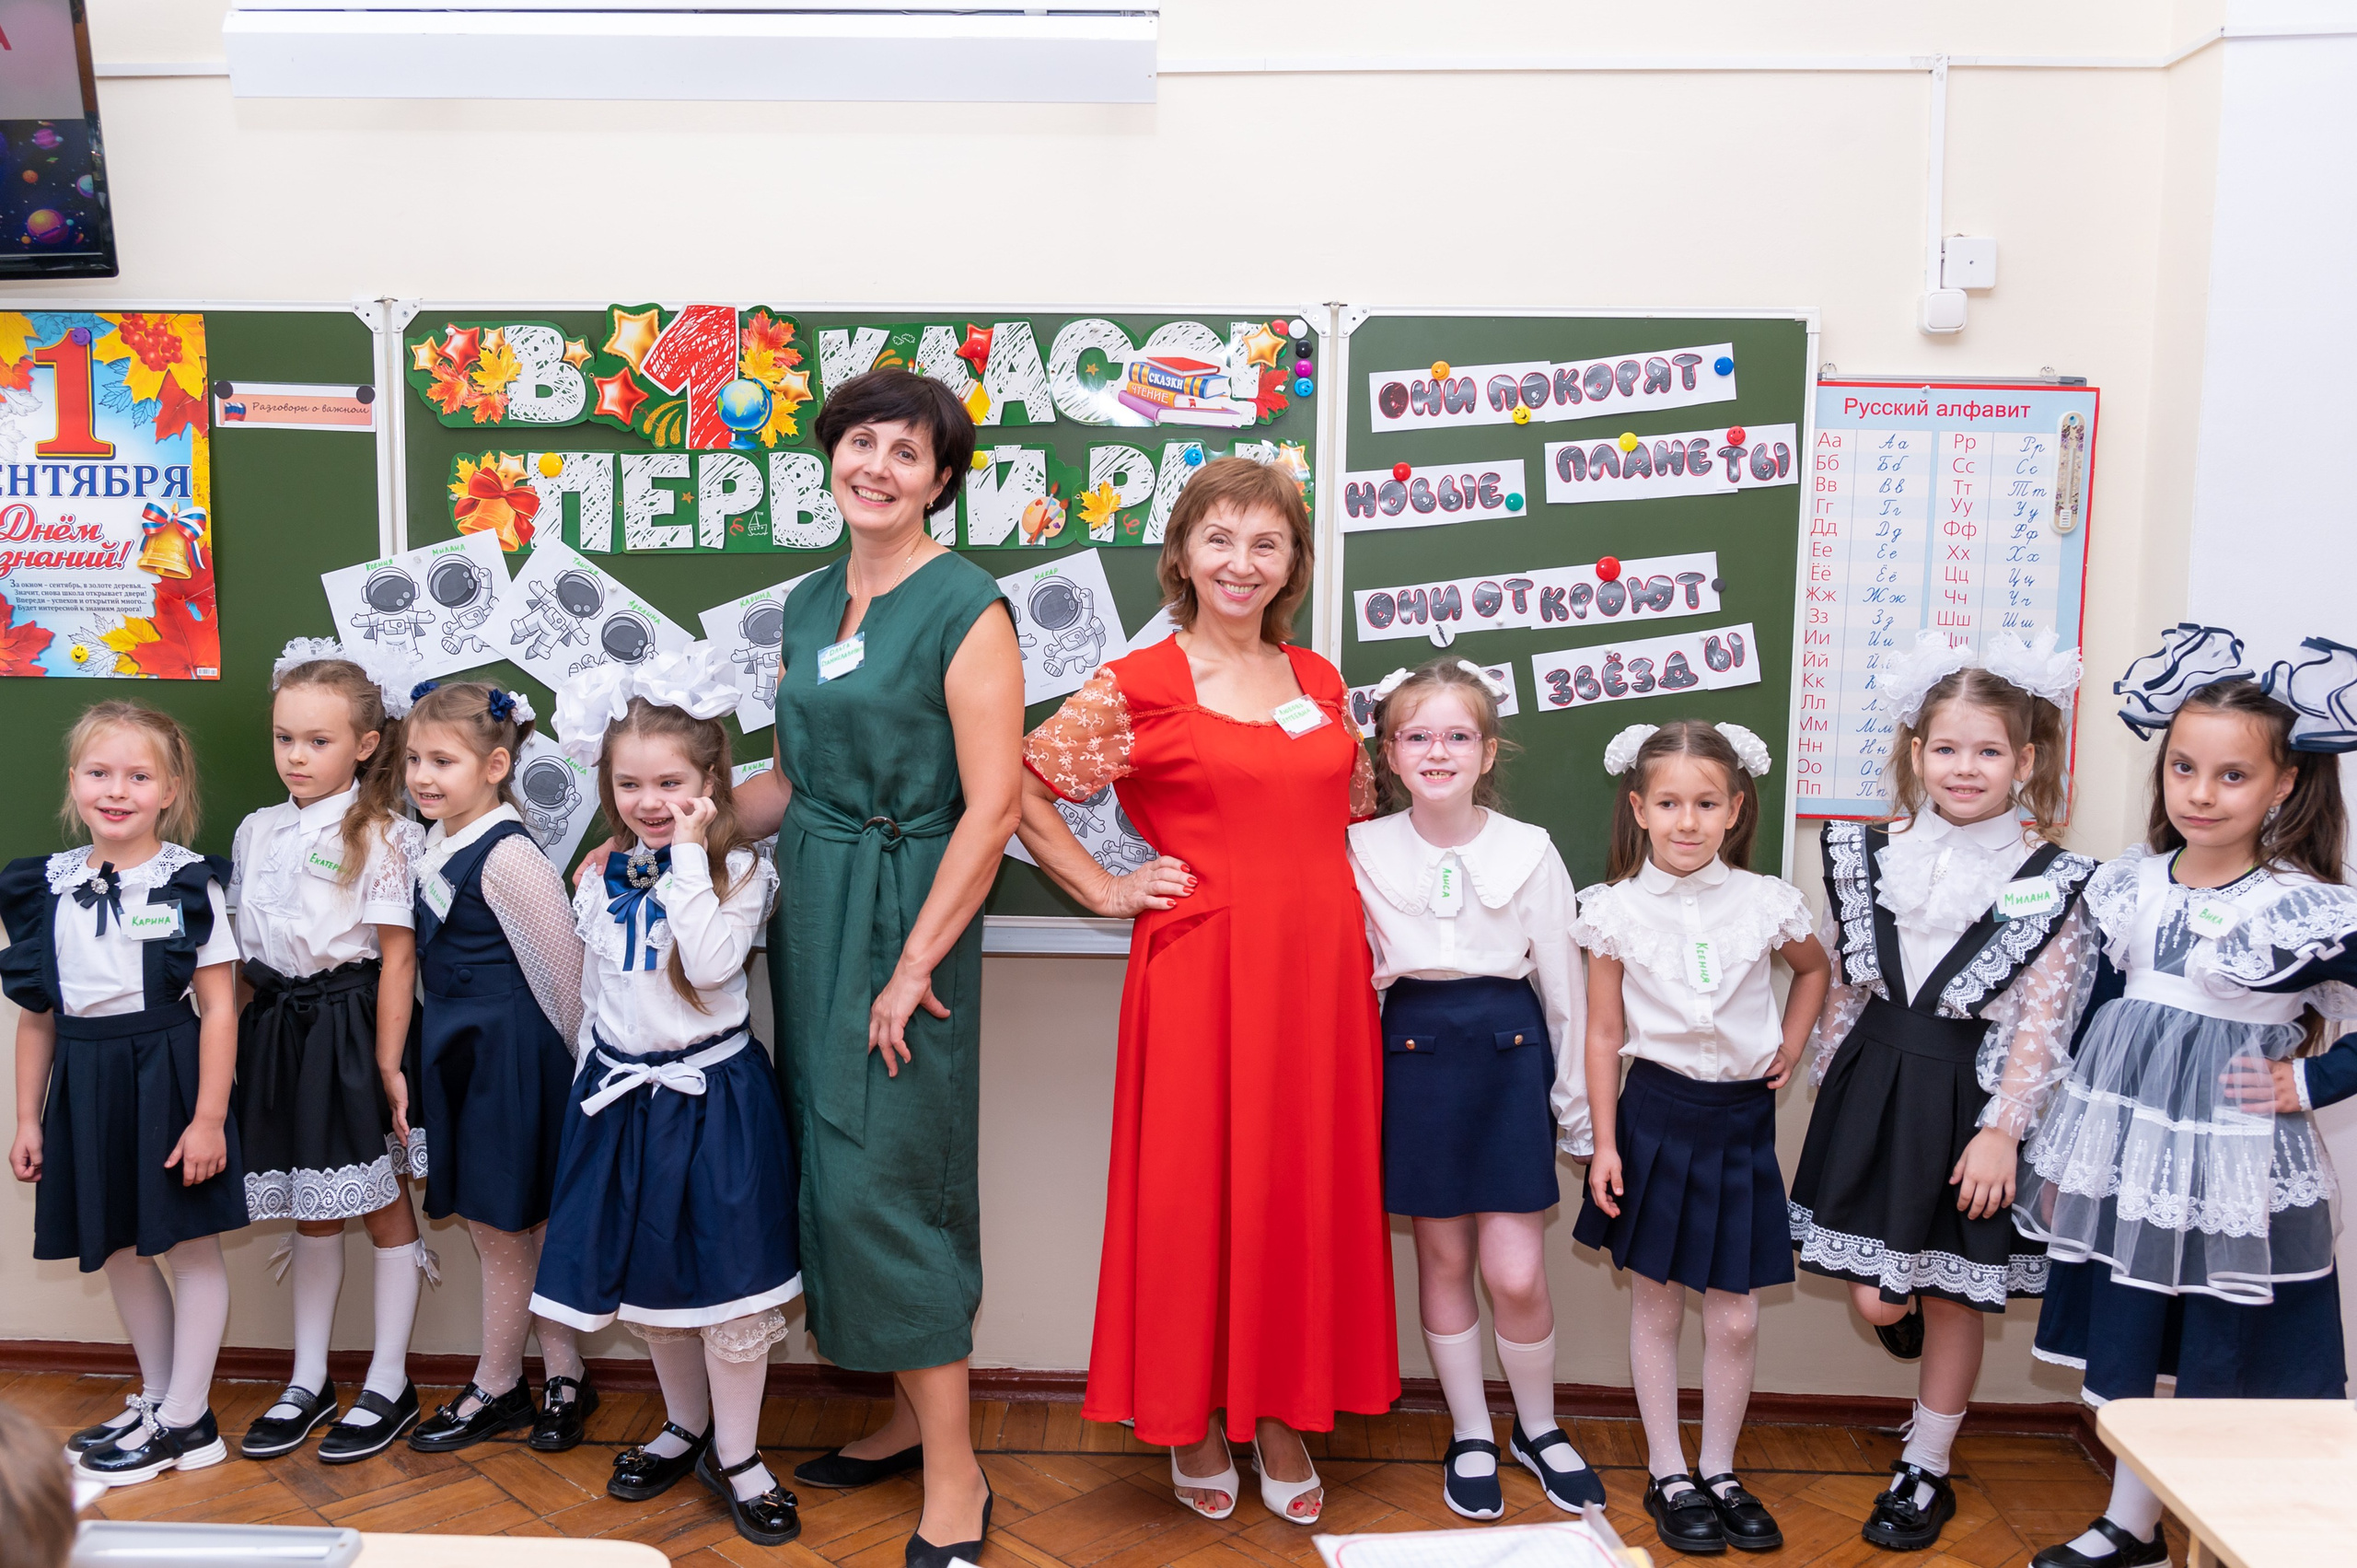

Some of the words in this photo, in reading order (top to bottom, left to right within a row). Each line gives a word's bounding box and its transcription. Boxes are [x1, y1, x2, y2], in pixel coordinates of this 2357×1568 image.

[503, 325, 586, 423] В
[640, 305, 740, 449] 1
[1148, 371, 1184, 390] СКАЗКИ
[1378, 376, 1477, 419] ОНИ
[1486, 353, 1702, 412] ПОКОРЯТ
[34, 328, 115, 459] 1
[1131, 384, 1169, 404] ЧТЕНИЕ
[252, 402, 309, 413] Разговоры
[322, 404, 370, 413] важном
[1843, 398, 1929, 420] Русский
[1936, 400, 2032, 421] алфавит
[1817, 432, 1841, 447] Аа
[1954, 434, 1977, 454] Рр
[1817, 454, 1839, 470] Бб
[1953, 458, 1975, 473] Сс
[0, 464, 192, 498] НТЯБРЯ
[1344, 471, 1505, 518] НОВЫЕ
[1556, 437, 1791, 483] ПЛАНЕТЫ
[1817, 476, 1837, 492] Вв
[1953, 480, 1972, 495] Тт
[528, 444, 1048, 552] ПЕРВЙ
[1817, 498, 1834, 514] Гг
[1951, 497, 1973, 517] Уу
[0, 504, 104, 541] Днём
[1810, 518, 1838, 537] Дд
[1944, 520, 1977, 540] Фф
[0, 540, 134, 578] знаний!
[1812, 541, 1832, 557] Ее
[1947, 545, 1969, 561] Хх
[10, 579, 19, 588] За
[1811, 563, 1831, 581] Ёё
[1945, 565, 1968, 584] Цц
[1364, 584, 1462, 629] ОНИ
[1472, 571, 1706, 622] ОТКРОЮТ
[1805, 587, 1837, 602] Жж
[1945, 589, 1967, 605] Чч
[116, 605, 142, 613] дорога!
[1808, 608, 1829, 623] Зз
[1937, 610, 1970, 626] Шш
[1805, 629, 1829, 645] Ии
[1544, 632, 1746, 706] ЗВЁЗДЫ
[1803, 651, 1829, 668] Йй
[1803, 673, 1825, 689] Кк
[1801, 694, 1826, 709] Лл
[1798, 738, 1822, 752] Нн
[1797, 780, 1821, 795] Пп
